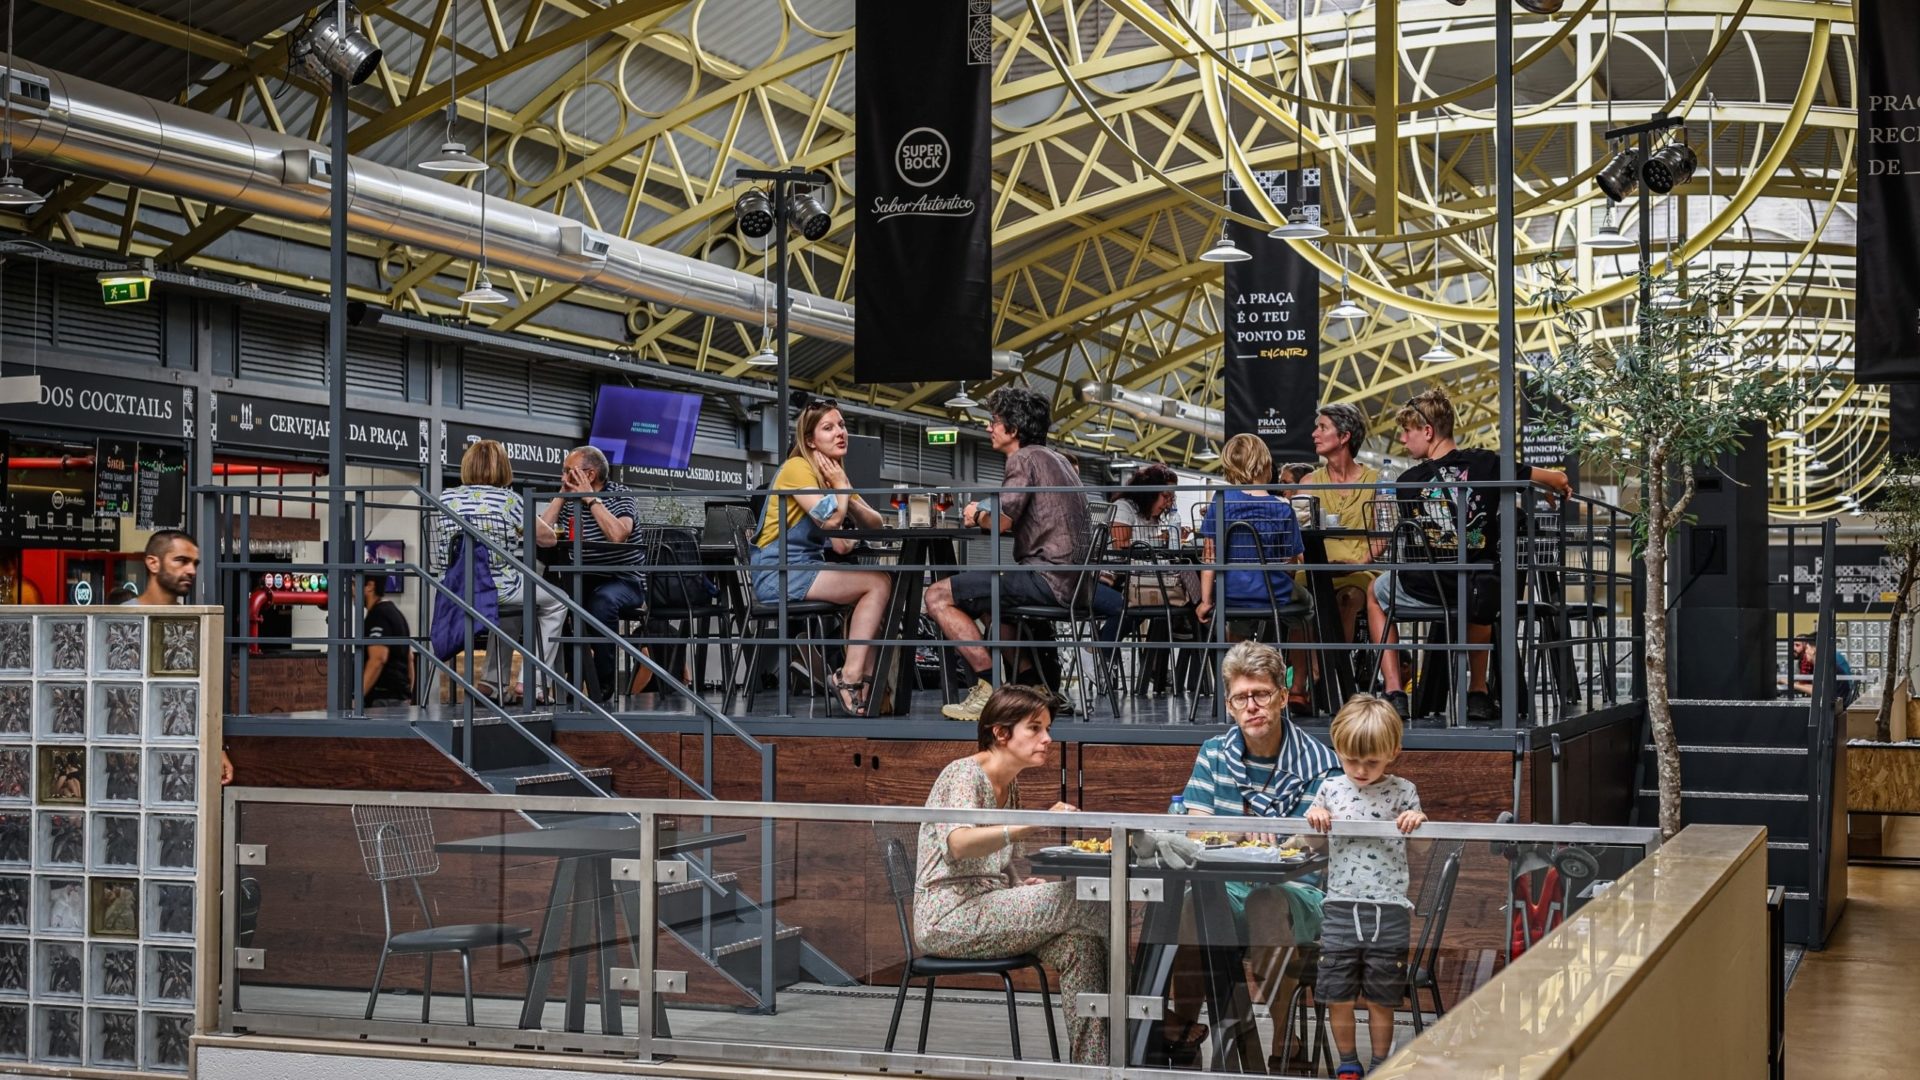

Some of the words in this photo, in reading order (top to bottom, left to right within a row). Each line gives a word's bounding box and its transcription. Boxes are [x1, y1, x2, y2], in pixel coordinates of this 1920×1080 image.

[1869, 94, 1920, 111] PRA
[1869, 126, 1920, 143] REC
[903, 144, 943, 157] SUPER
[904, 156, 941, 169] BOCK
[1868, 160, 1900, 175] DE
[871, 196, 912, 213] Sabor
[1237, 294, 1246, 304] A
[1250, 292, 1295, 305] PRAÇA
[1237, 311, 1245, 323] É
[1249, 312, 1258, 322] O
[1262, 311, 1289, 322] TEU
[1237, 331, 1282, 342] PONTO
[1286, 330, 1306, 340] DE
[1260, 347, 1308, 359] ENCONTRO
[37, 385, 74, 408] DOS
[79, 389, 172, 419] COCKTAILS
[1258, 418, 1286, 428] PRAÇA
[349, 424, 367, 442] DA
[370, 426, 408, 450] PRAÇA
[501, 442, 544, 462] BERNA
[546, 447, 561, 464] DE
[1523, 444, 1568, 453] MUNICIPAL
[1530, 455, 1558, 464] PEDRO
[1558, 455, 1565, 463] V
[685, 467, 714, 481] CASEIRO
[715, 470, 720, 482] E
[721, 470, 743, 484] DOCES
